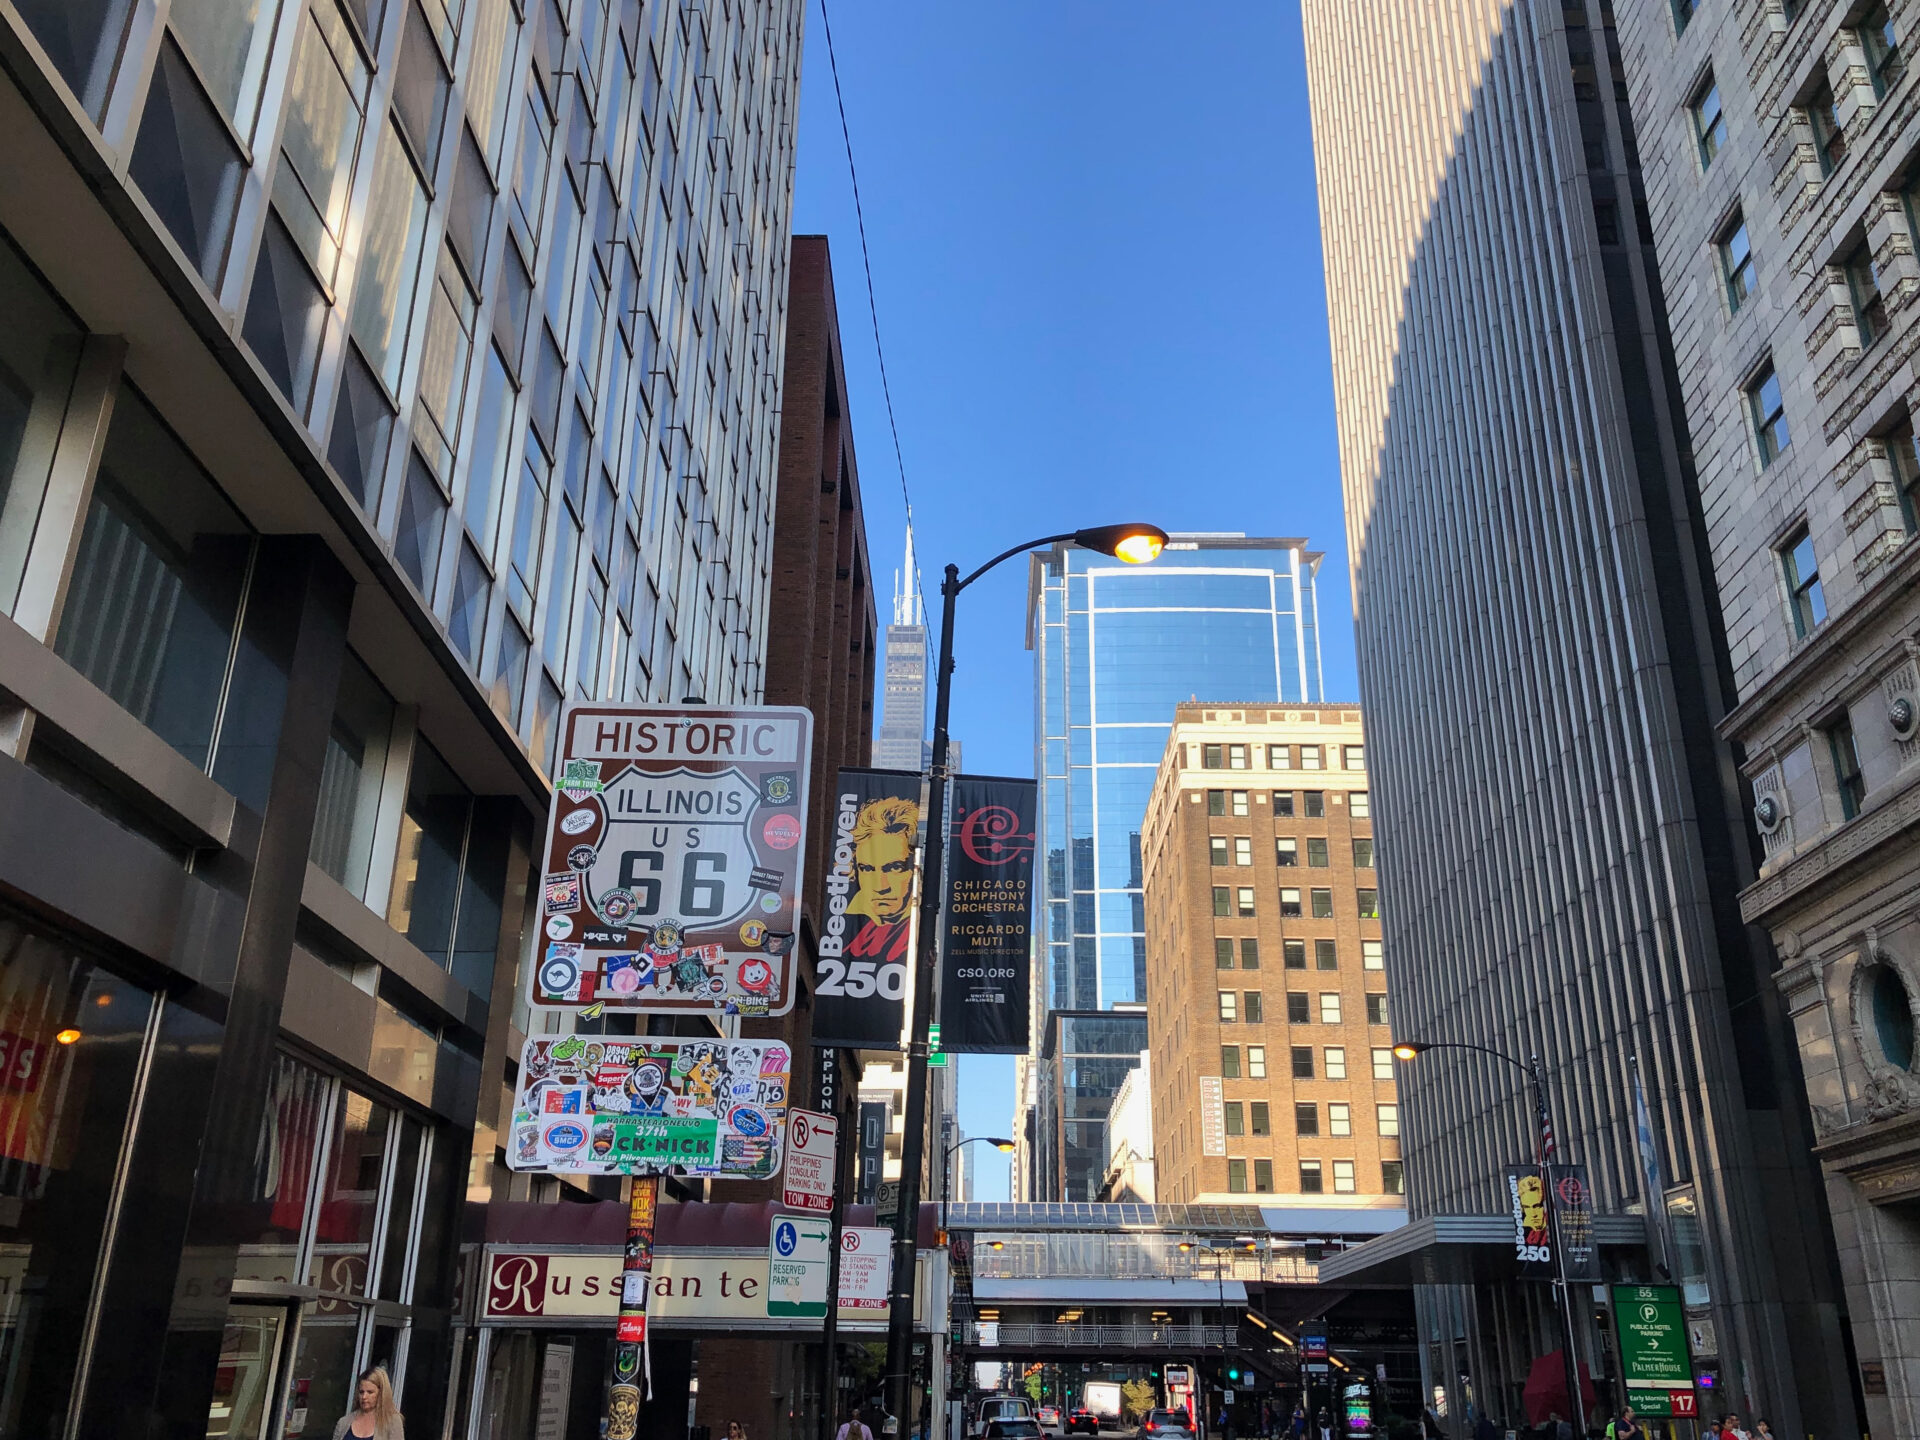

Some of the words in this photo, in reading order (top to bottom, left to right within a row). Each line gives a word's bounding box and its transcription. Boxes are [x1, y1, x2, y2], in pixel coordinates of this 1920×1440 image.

[595, 721, 776, 756] HISTORIC
[617, 788, 743, 815] ILLINOIS
[818, 793, 858, 958] Beethoven
[617, 850, 728, 918] 66
[953, 880, 1026, 891] CHICAGO
[555, 892, 568, 902] 66
[953, 891, 1026, 902] SYMPHONY
[952, 902, 1026, 913] ORCHESTRA
[951, 925, 1025, 935] RICCARDO
[971, 936, 1003, 946] MUTI
[957, 968, 1016, 979] CSO.ORG
[814, 959, 908, 1001] 250
[604, 1054, 629, 1065] KNY
[607, 1117, 701, 1128] HARRASTEAJONEUVO
[635, 1126, 668, 1137] 37th
[553, 1137, 578, 1145] SMCF
[670, 1156, 711, 1165] 4.8.2019
[790, 1155, 822, 1169] PHILIPPINES
[790, 1166, 820, 1179] CONSULATE
[789, 1177, 811, 1189] PARKING
[813, 1181, 827, 1191] ONLY
[631, 1198, 650, 1210] WOK
[787, 1192, 805, 1206] TOW
[808, 1195, 829, 1209] ZONE
[1508, 1175, 1526, 1245] Beethoven
[1516, 1245, 1551, 1262] 250
[849, 1256, 878, 1264] STOPPING
[773, 1264, 806, 1275] RESERVED
[490, 1255, 703, 1313] Russan
[772, 1276, 800, 1286] PARKG
[838, 1299, 855, 1307] TOW
[859, 1299, 883, 1308] ZONE
[1645, 1395, 1669, 1403] Morning
